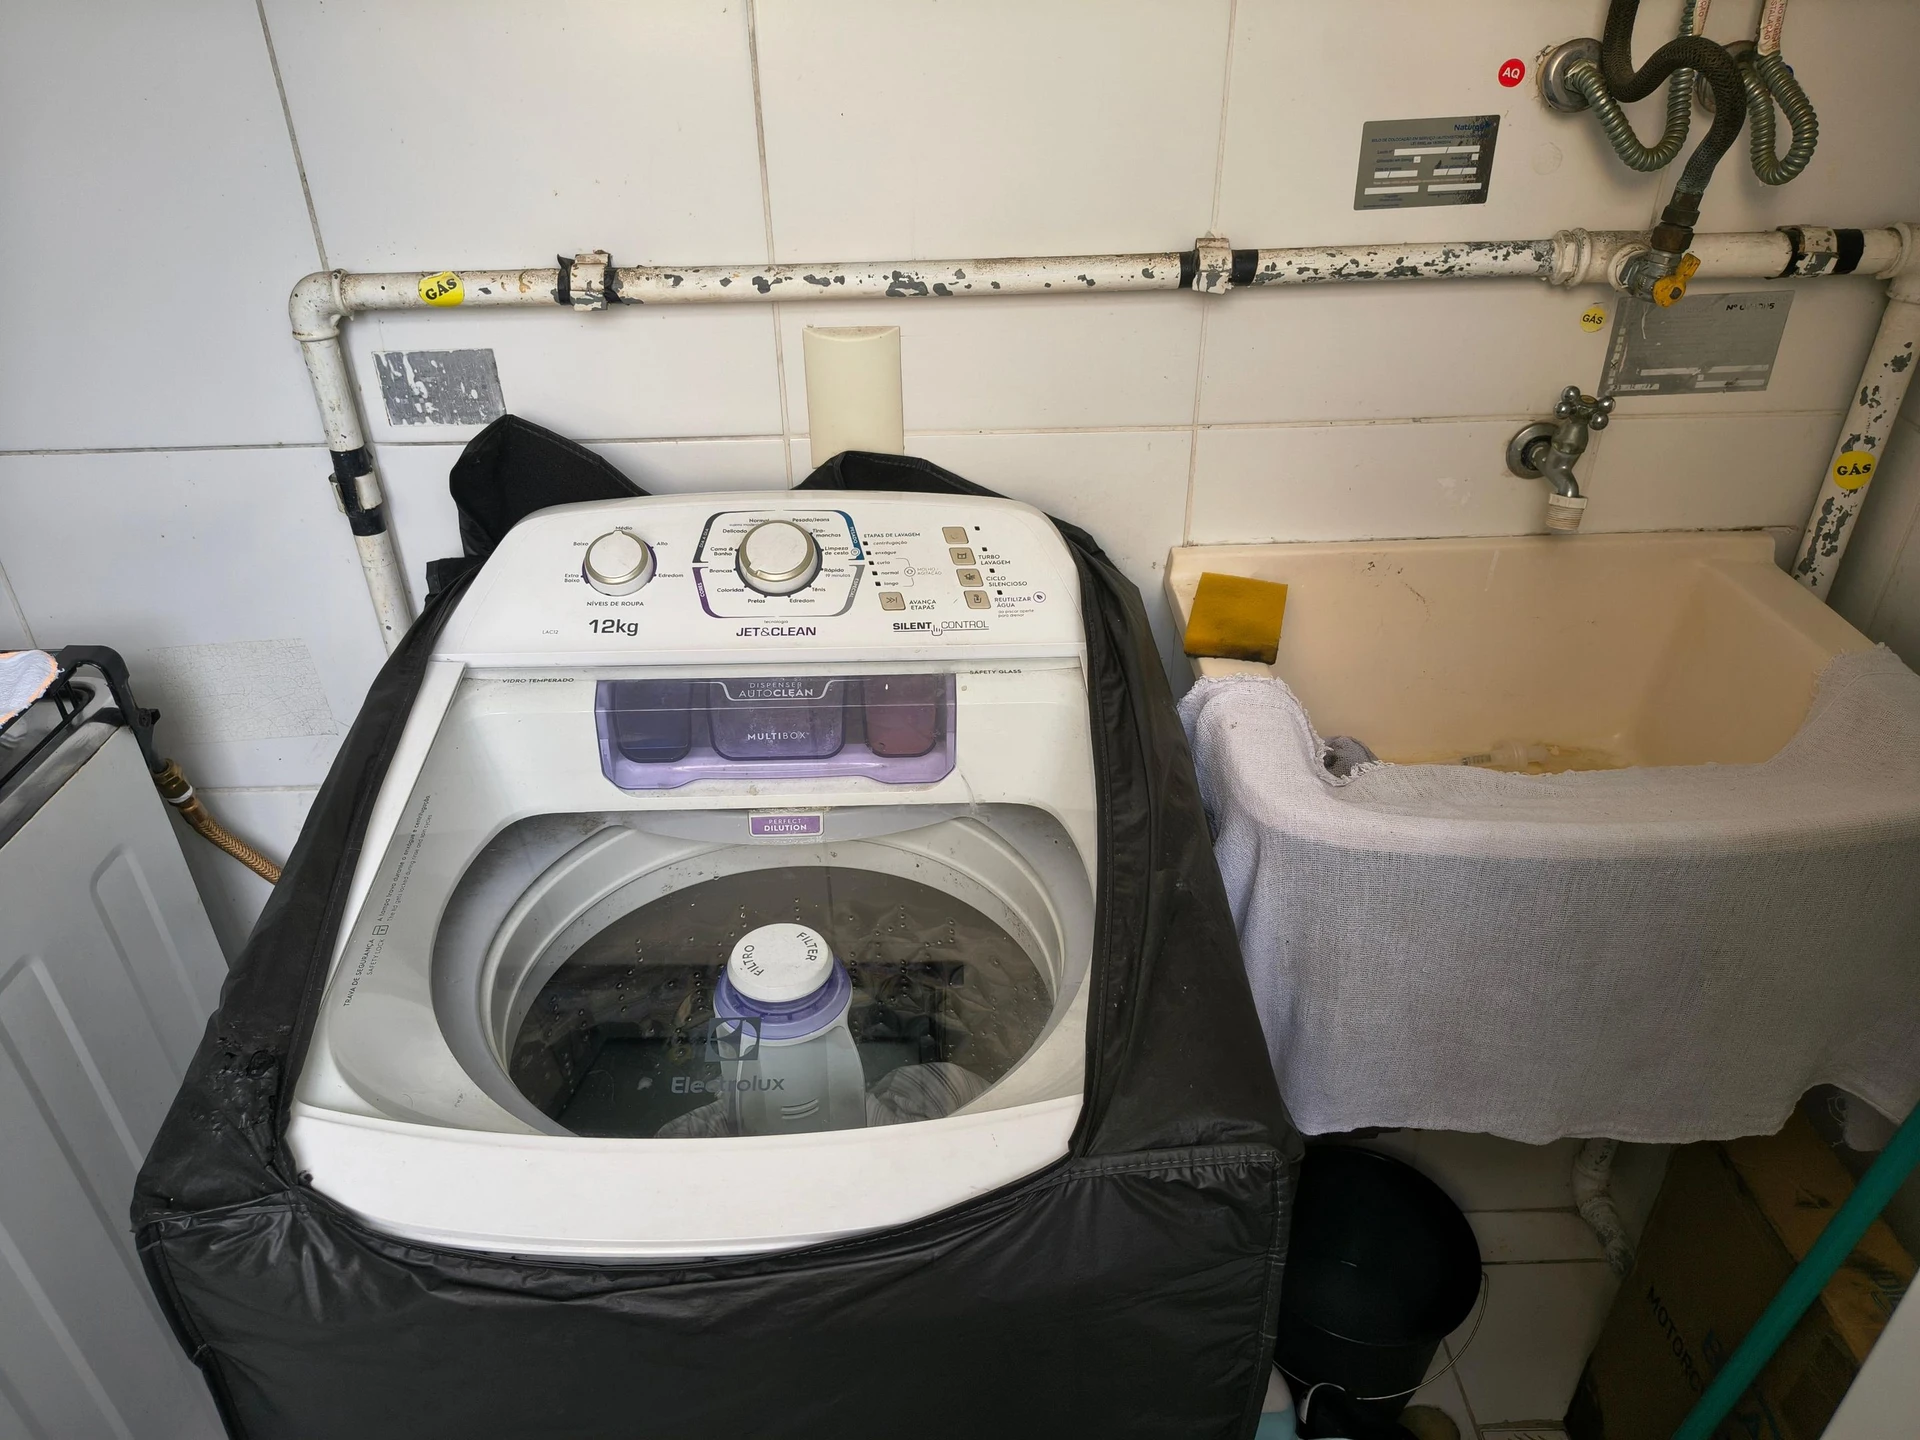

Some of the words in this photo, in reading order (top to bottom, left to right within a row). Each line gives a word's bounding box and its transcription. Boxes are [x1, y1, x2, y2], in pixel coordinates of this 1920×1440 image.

[1502, 67, 1521, 80] AQ
[425, 278, 458, 300] GÁS
[1582, 313, 1603, 325] GÁS
[1836, 463, 1872, 476] GÁS
[588, 619, 639, 637] 12kg
[735, 626, 817, 637] JET&CLEAN
[892, 621, 932, 630] SILENT
[940, 620, 990, 629] CONTROL
[749, 681, 803, 689] DISPENSER
[738, 688, 814, 698] AUTOCLEAN
[764, 824, 808, 832] DILUTION
[796, 931, 819, 962] FILTER
[355, 938, 375, 976] SEGURANÇA
[366, 954, 379, 976] SAFETY
[375, 938, 385, 954] LOCK
[742, 944, 765, 976] FILTRO
[351, 977, 361, 986] DE
[343, 986, 356, 1007] TRAVA
[671, 1075, 785, 1094] Electrolux
